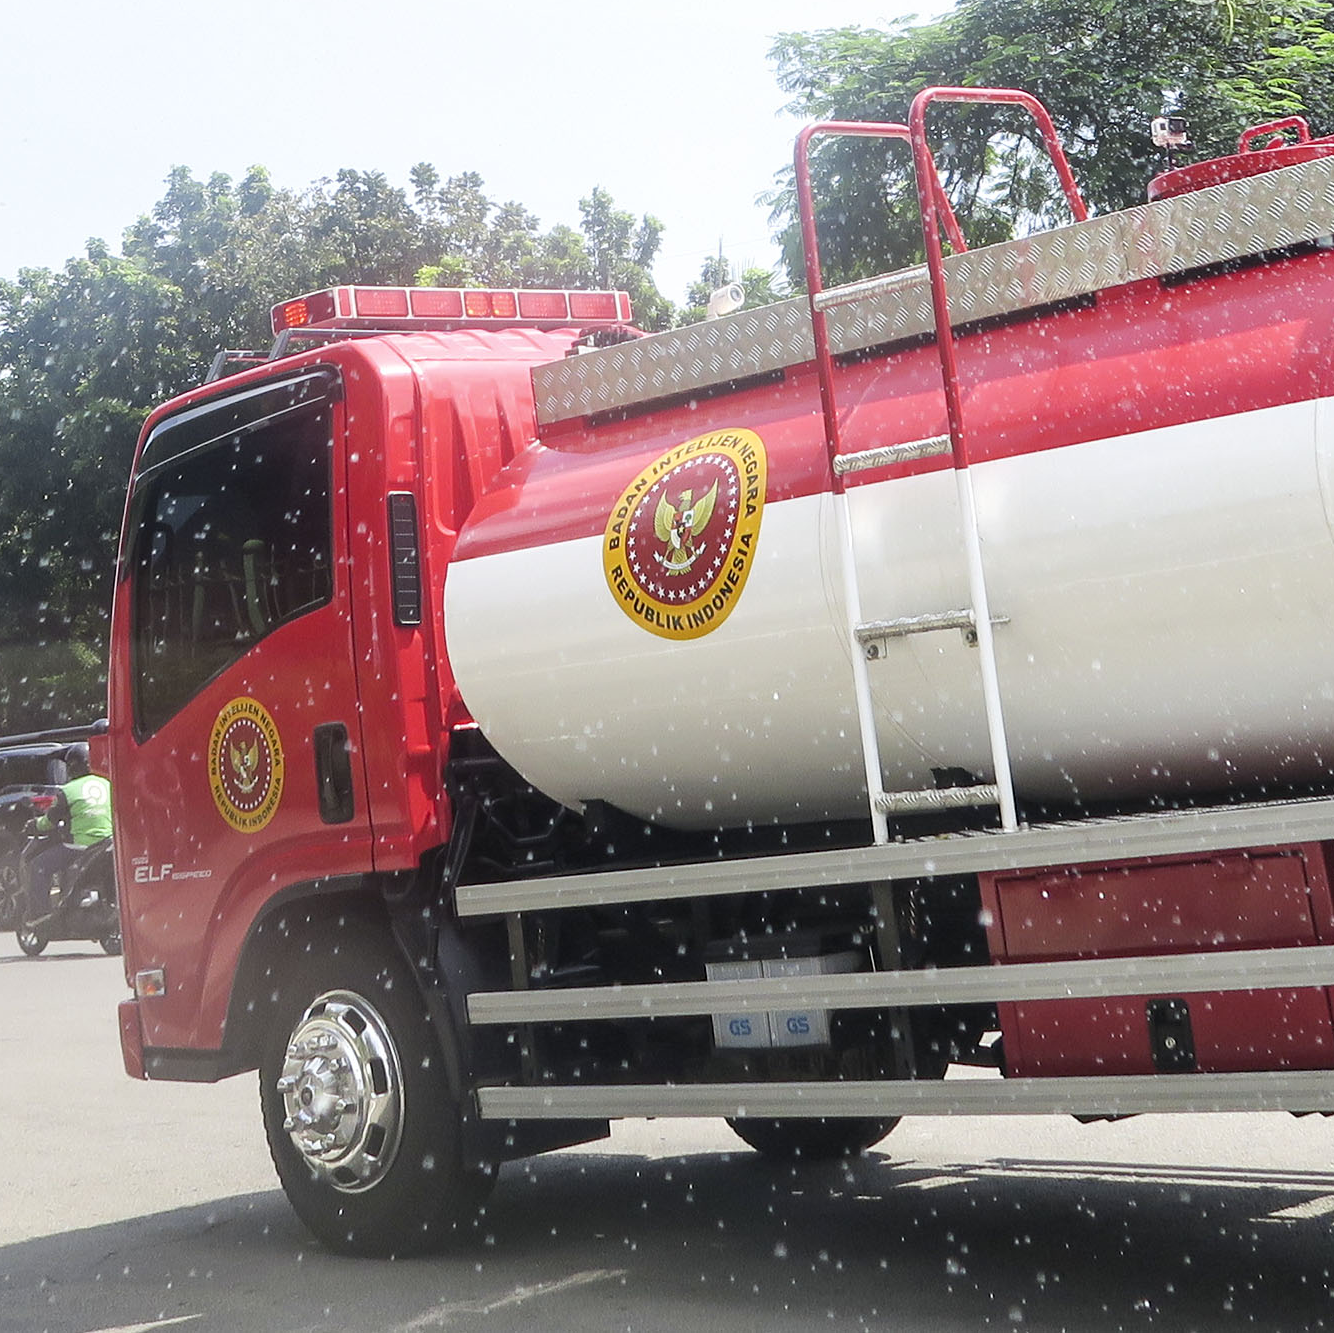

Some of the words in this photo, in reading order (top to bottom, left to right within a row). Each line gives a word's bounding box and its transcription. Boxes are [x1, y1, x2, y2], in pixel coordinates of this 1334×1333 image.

[609, 478, 647, 551] BADAN
[652, 435, 742, 475] INTELIJEN
[738, 442, 758, 519] NEGARA
[611, 565, 685, 631] REPUBLIK
[687, 533, 753, 629] INDONESIA
[210, 730, 222, 775] BADAN
[219, 703, 260, 728] INTELIJEN
[260, 713, 281, 766] NEGARA
[214, 785, 247, 829] REPUBLIK
[249, 777, 281, 827] INDONESIA
[134, 863, 174, 883] ELF
[729, 1019, 752, 1036] GS
[787, 1016, 810, 1034] GS
